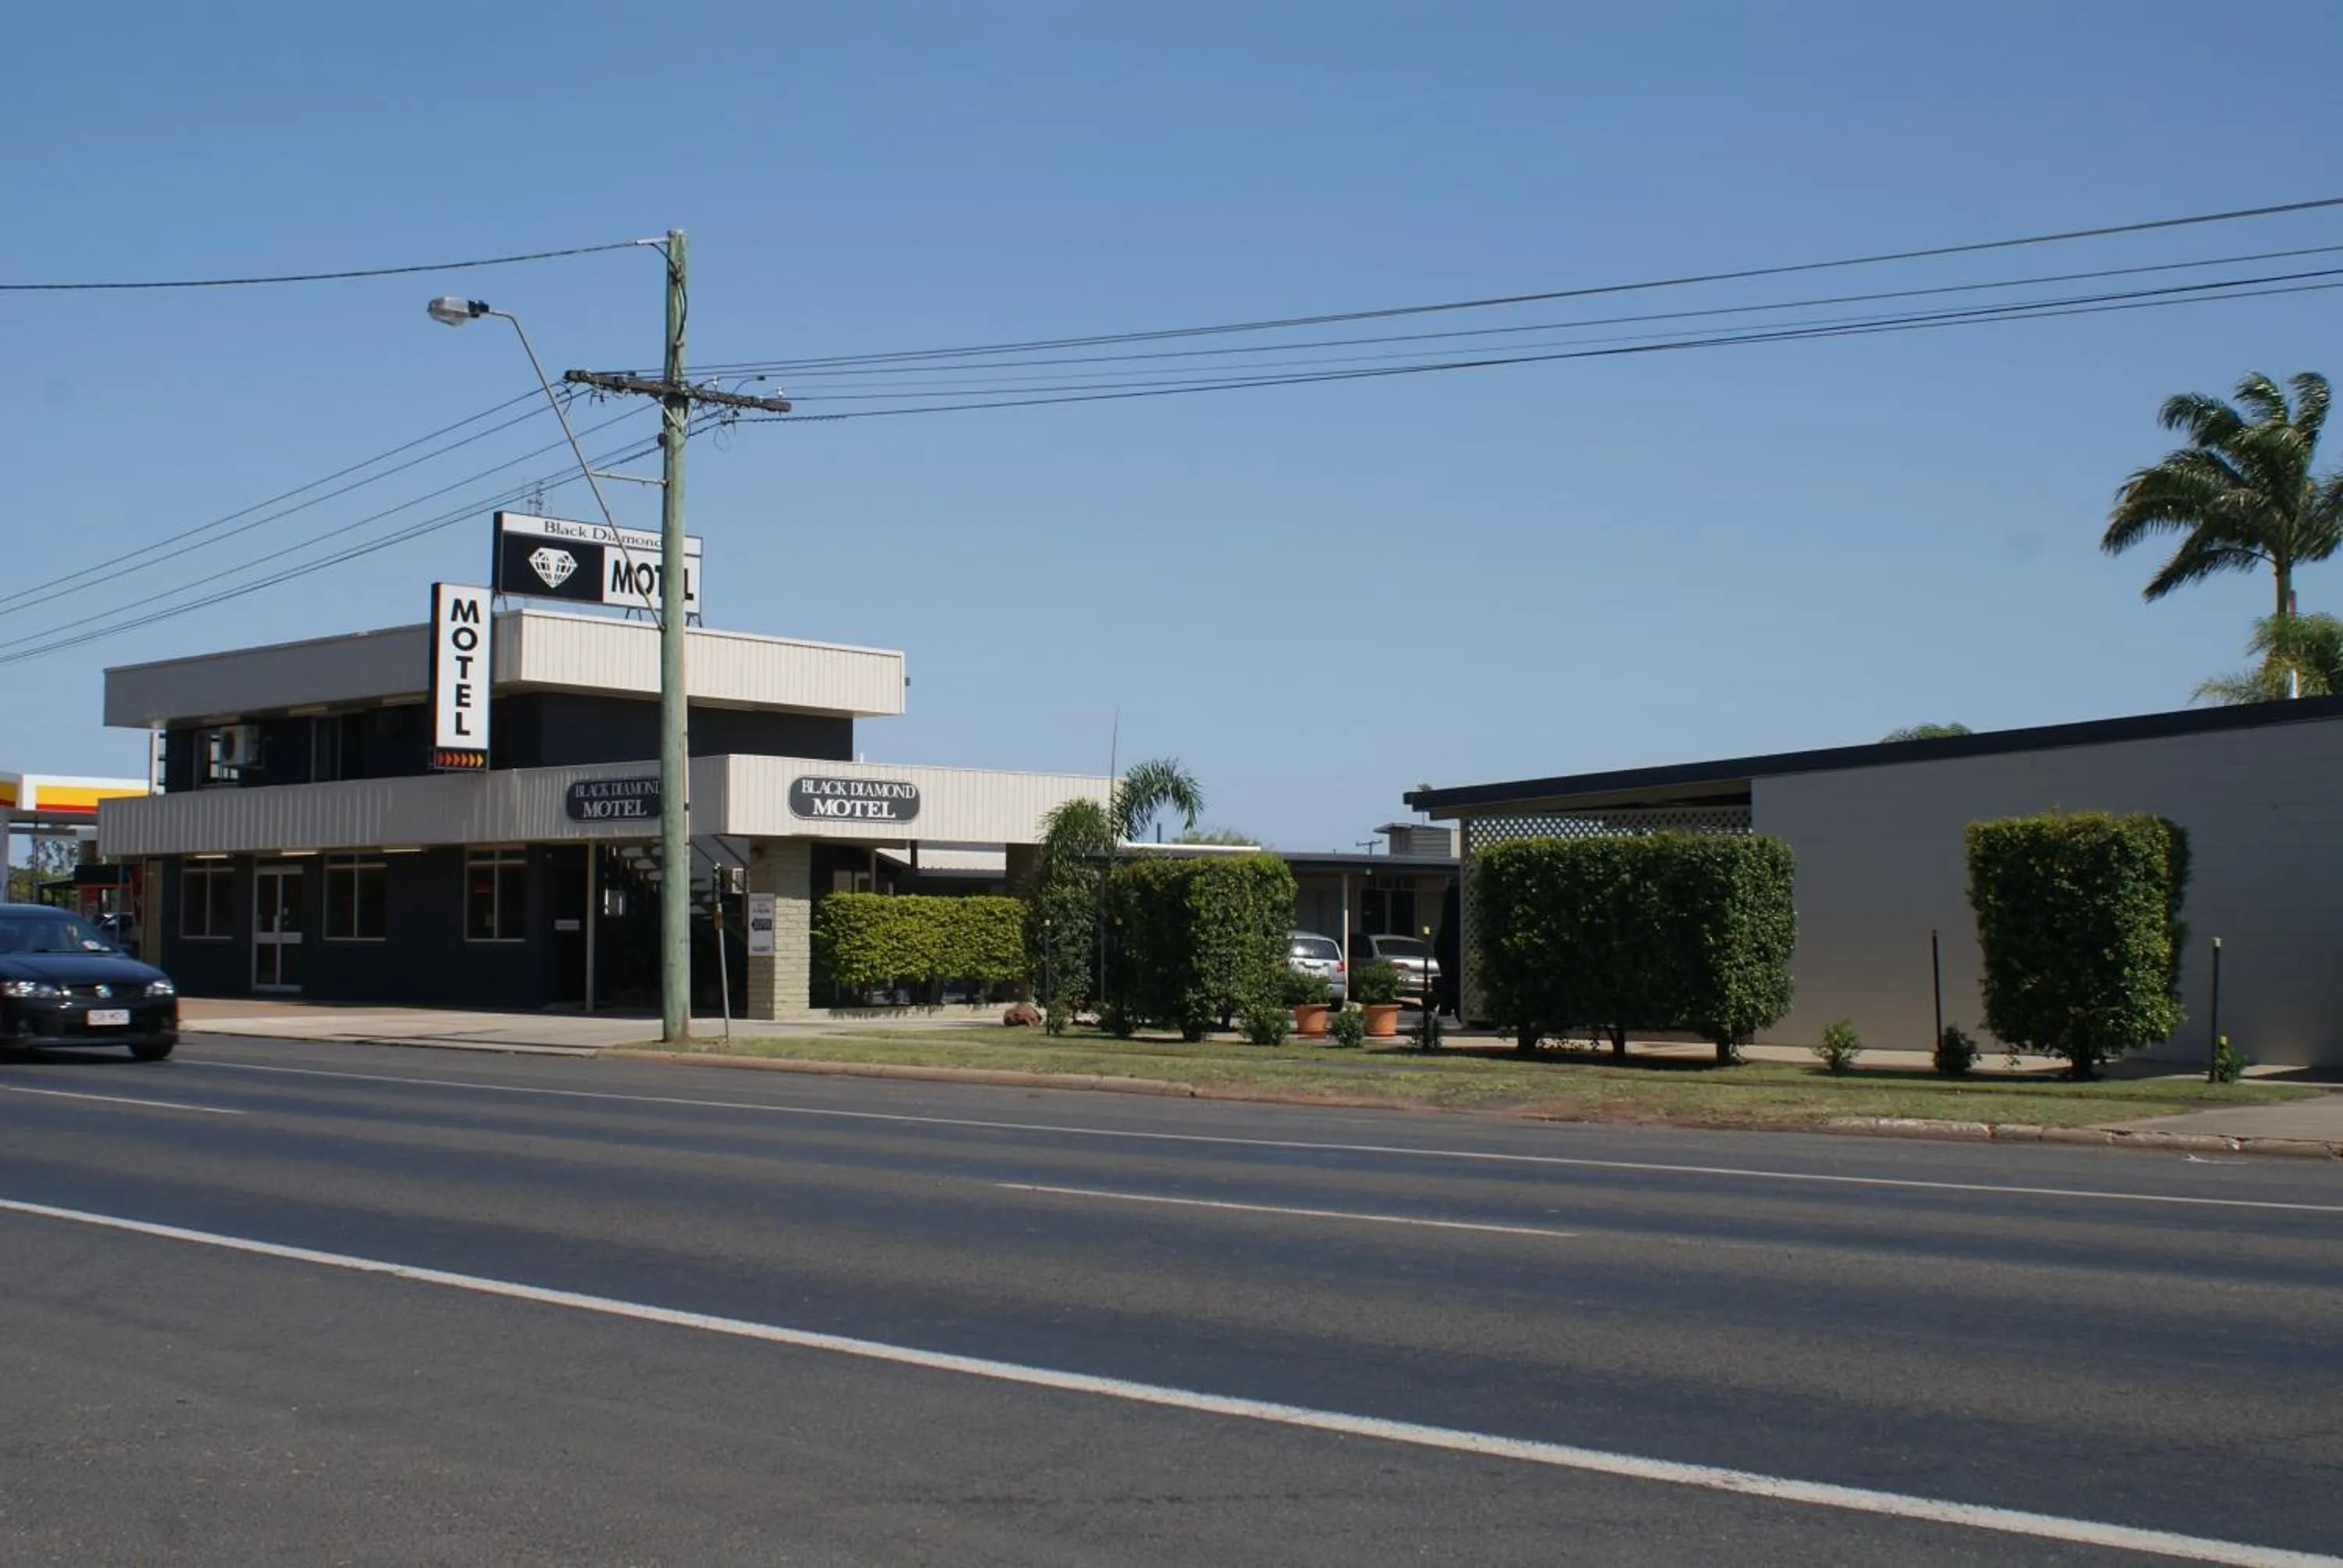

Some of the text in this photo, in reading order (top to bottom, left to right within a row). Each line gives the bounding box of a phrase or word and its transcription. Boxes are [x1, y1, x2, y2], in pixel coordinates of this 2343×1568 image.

[544, 521, 588, 539] Black
[611, 559, 694, 600] MOTL
[451, 598, 480, 736] MOTEL
[575, 783, 609, 798] BLACK
[801, 779, 916, 799] BLACK DIAMOND
[582, 799, 647, 818] MOTEL
[811, 797, 897, 818] MOTEL
